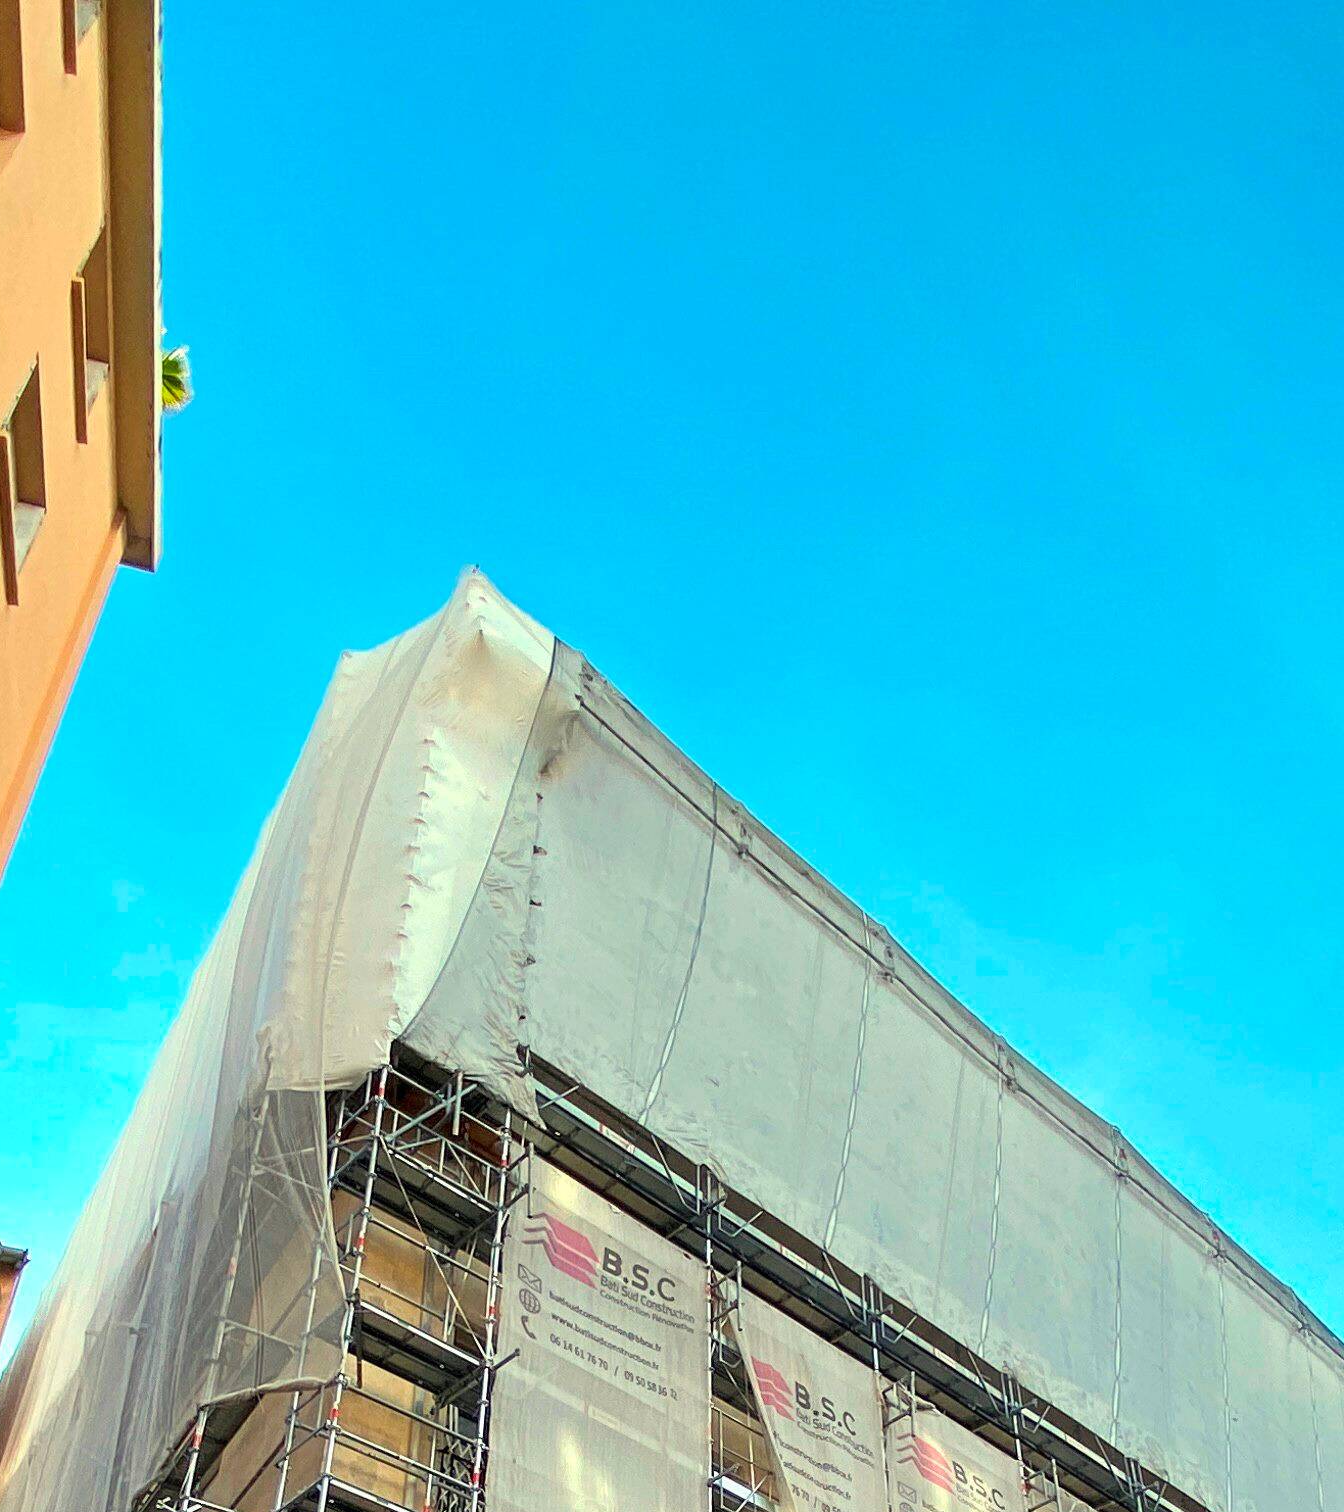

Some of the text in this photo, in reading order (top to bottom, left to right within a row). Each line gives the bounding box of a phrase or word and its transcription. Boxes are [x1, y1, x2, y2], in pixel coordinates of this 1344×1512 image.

[601, 1275, 695, 1324] Bati Sud Construction
[602, 1247, 676, 1302] B.S.C
[795, 1381, 856, 1436] B.S.C
[952, 1460, 1005, 1511] B.S.C
